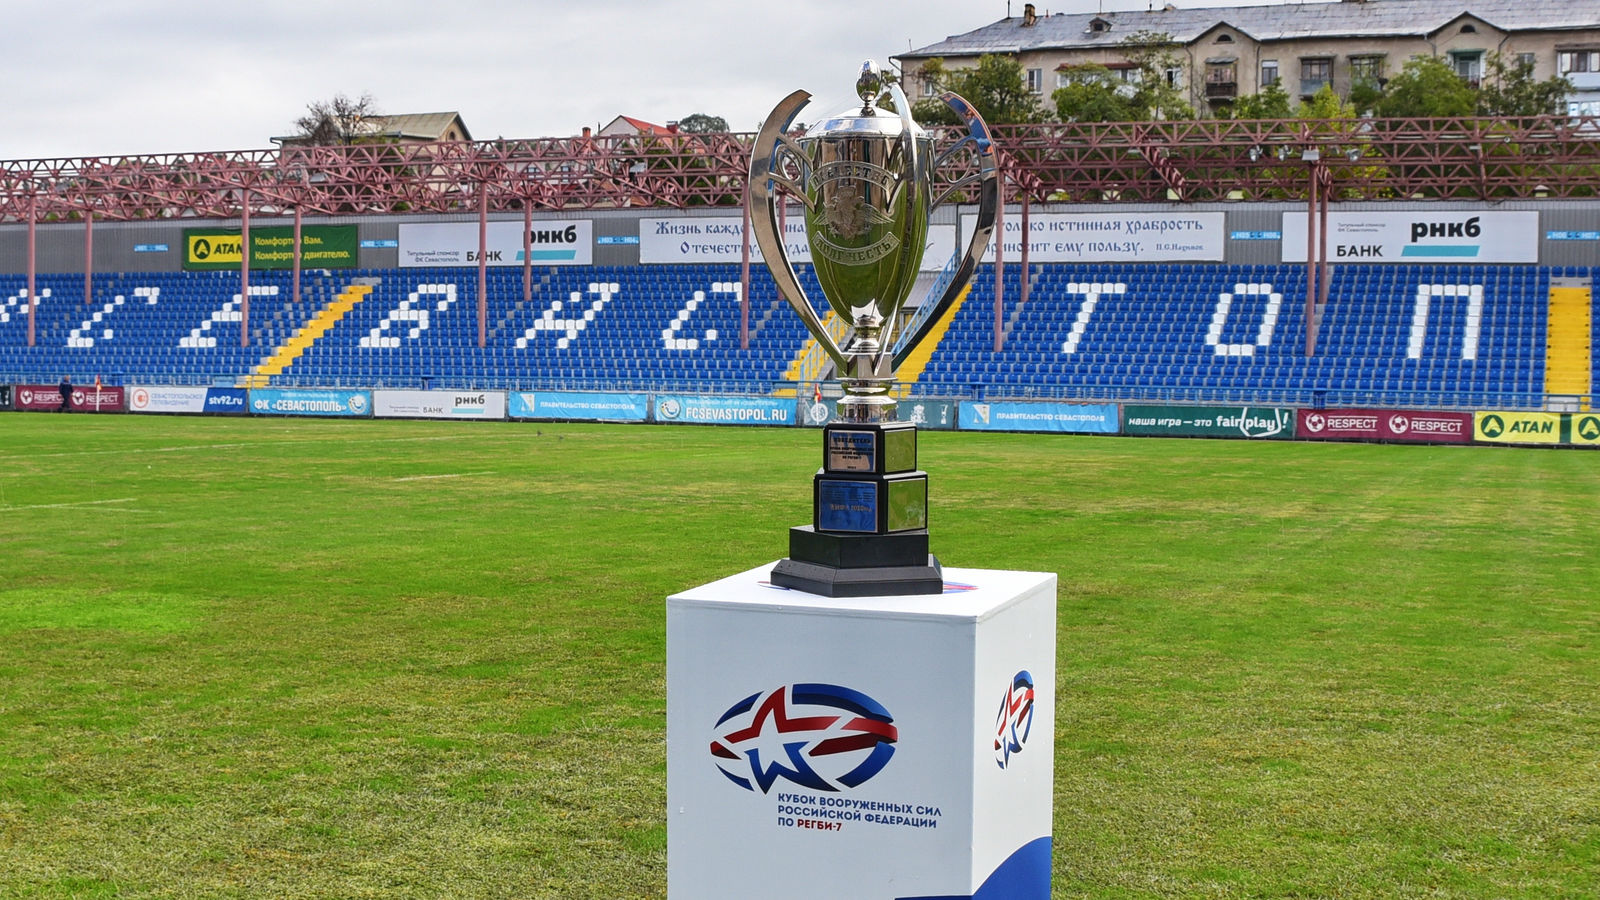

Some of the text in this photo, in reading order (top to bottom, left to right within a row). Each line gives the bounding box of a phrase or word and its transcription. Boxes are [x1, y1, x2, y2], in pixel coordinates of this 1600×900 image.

[655, 221, 701, 235] Жизнь
[996, 220, 1203, 235] олко истинная храбрость
[1411, 216, 1481, 243] рнкб
[1054, 242, 1084, 256] ему
[1088, 241, 1144, 256] пользу.
[1336, 245, 1383, 257] БАНК
[34, 393, 63, 402] RESPEC
[209, 396, 243, 405] stv92.ru
[455, 394, 485, 407] рнкб
[254, 399, 347, 412] ФК «СЕВАСТОПОЛЬ»
[685, 407, 787, 421] FCSEVASTOPOL.RU
[1128, 417, 1156, 426] наша
[1157, 418, 1182, 428] игра
[1193, 419, 1212, 427] это
[1327, 418, 1378, 429] RESPECT
[1411, 420, 1463, 432] RESPECT
[1509, 421, 1554, 433] ATAN
[778, 793, 942, 817] КУБОК ВООРУЖЕННЫХ СИЛ
[778, 805, 937, 828] РОССИЙСКОЙ ФЕДЕРАЦИИ
[778, 817, 842, 832] ПО РЕГБИ-7
